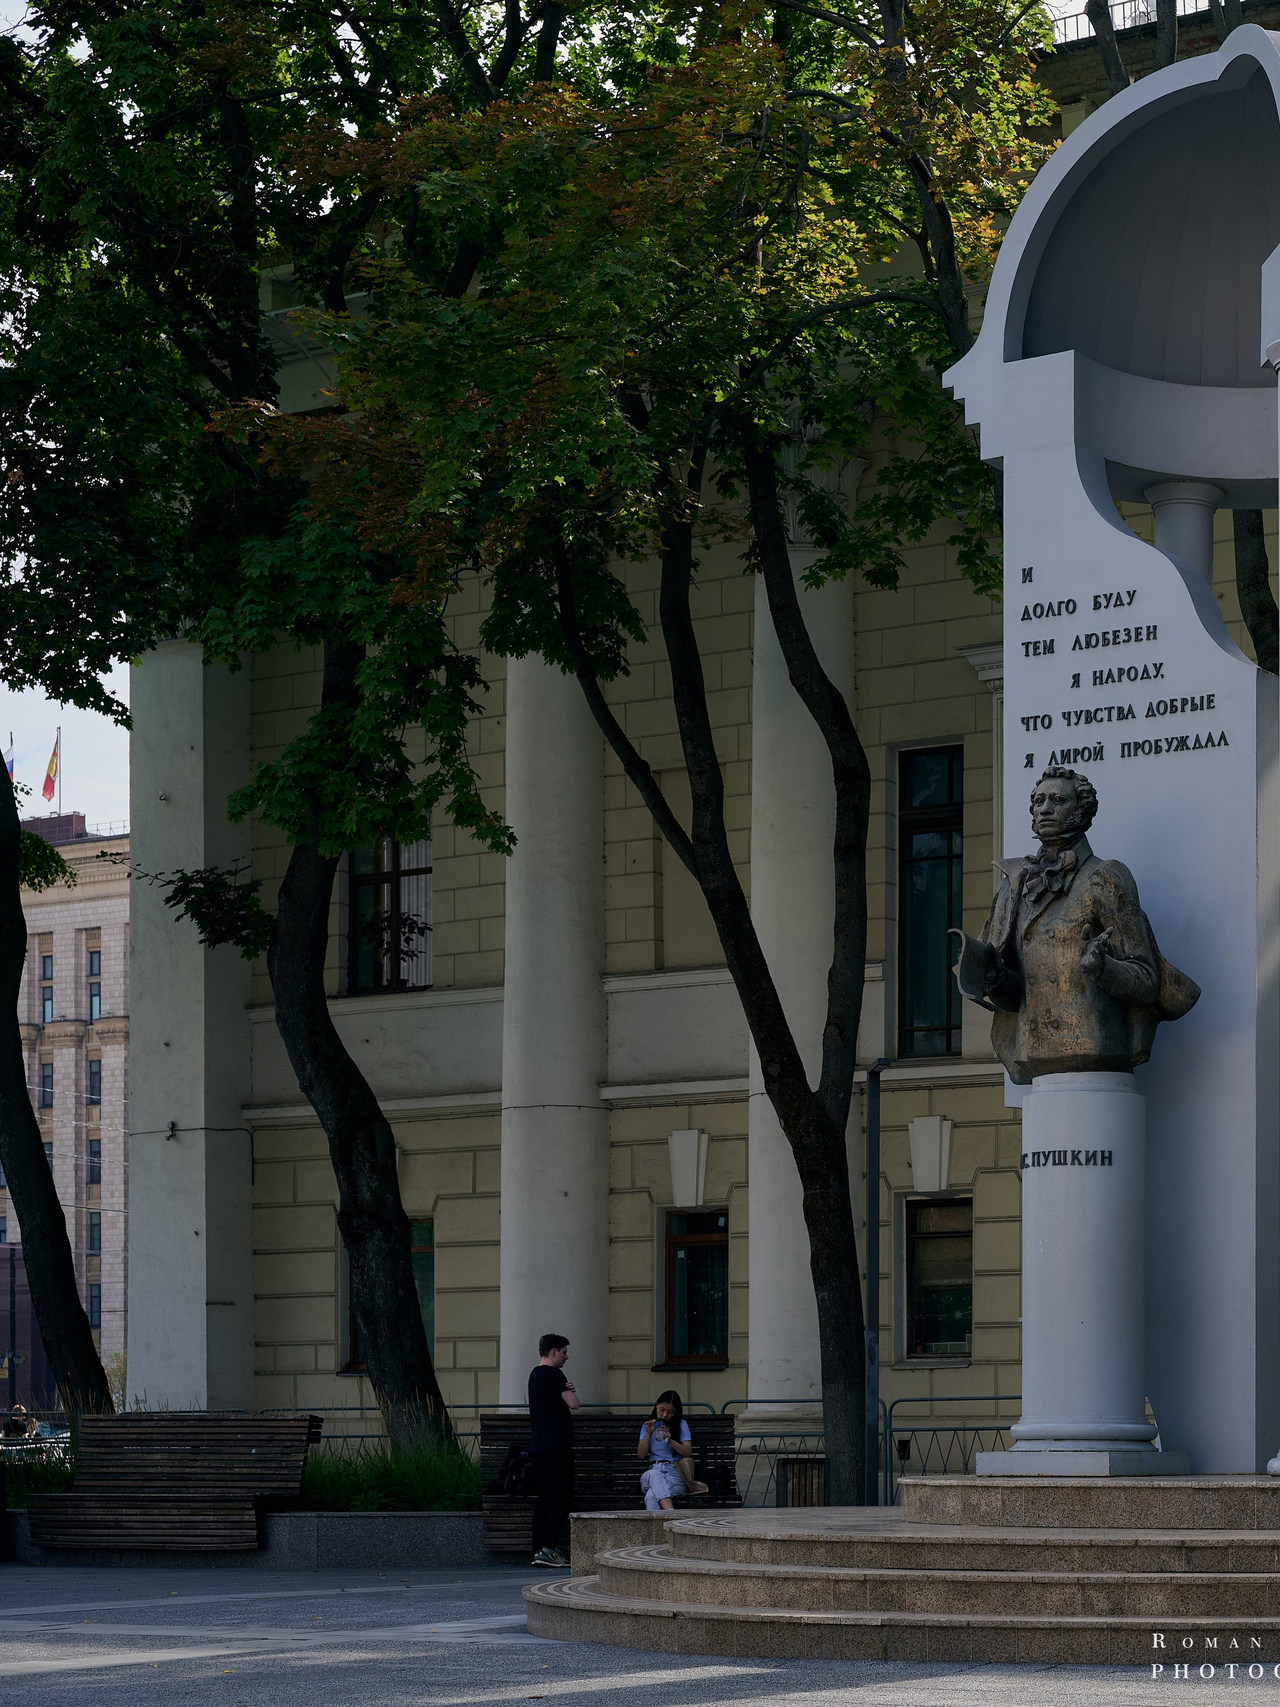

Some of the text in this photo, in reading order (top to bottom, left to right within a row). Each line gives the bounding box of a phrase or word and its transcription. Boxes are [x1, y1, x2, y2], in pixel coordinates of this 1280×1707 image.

[1021, 566, 1034, 584] И
[1020, 589, 1137, 622] ДОЛГО БУДУ
[1021, 624, 1158, 657] ТЕМ ЛЮБЕЗЕН
[1070, 662, 1165, 689] Я НАРОДУ,
[1020, 693, 1216, 732] ЧТО ЧУВСТВА ДОБРЫЕ
[1023, 730, 1230, 769] Я ЛИРОЙ ПРОБУЖДАЛ
